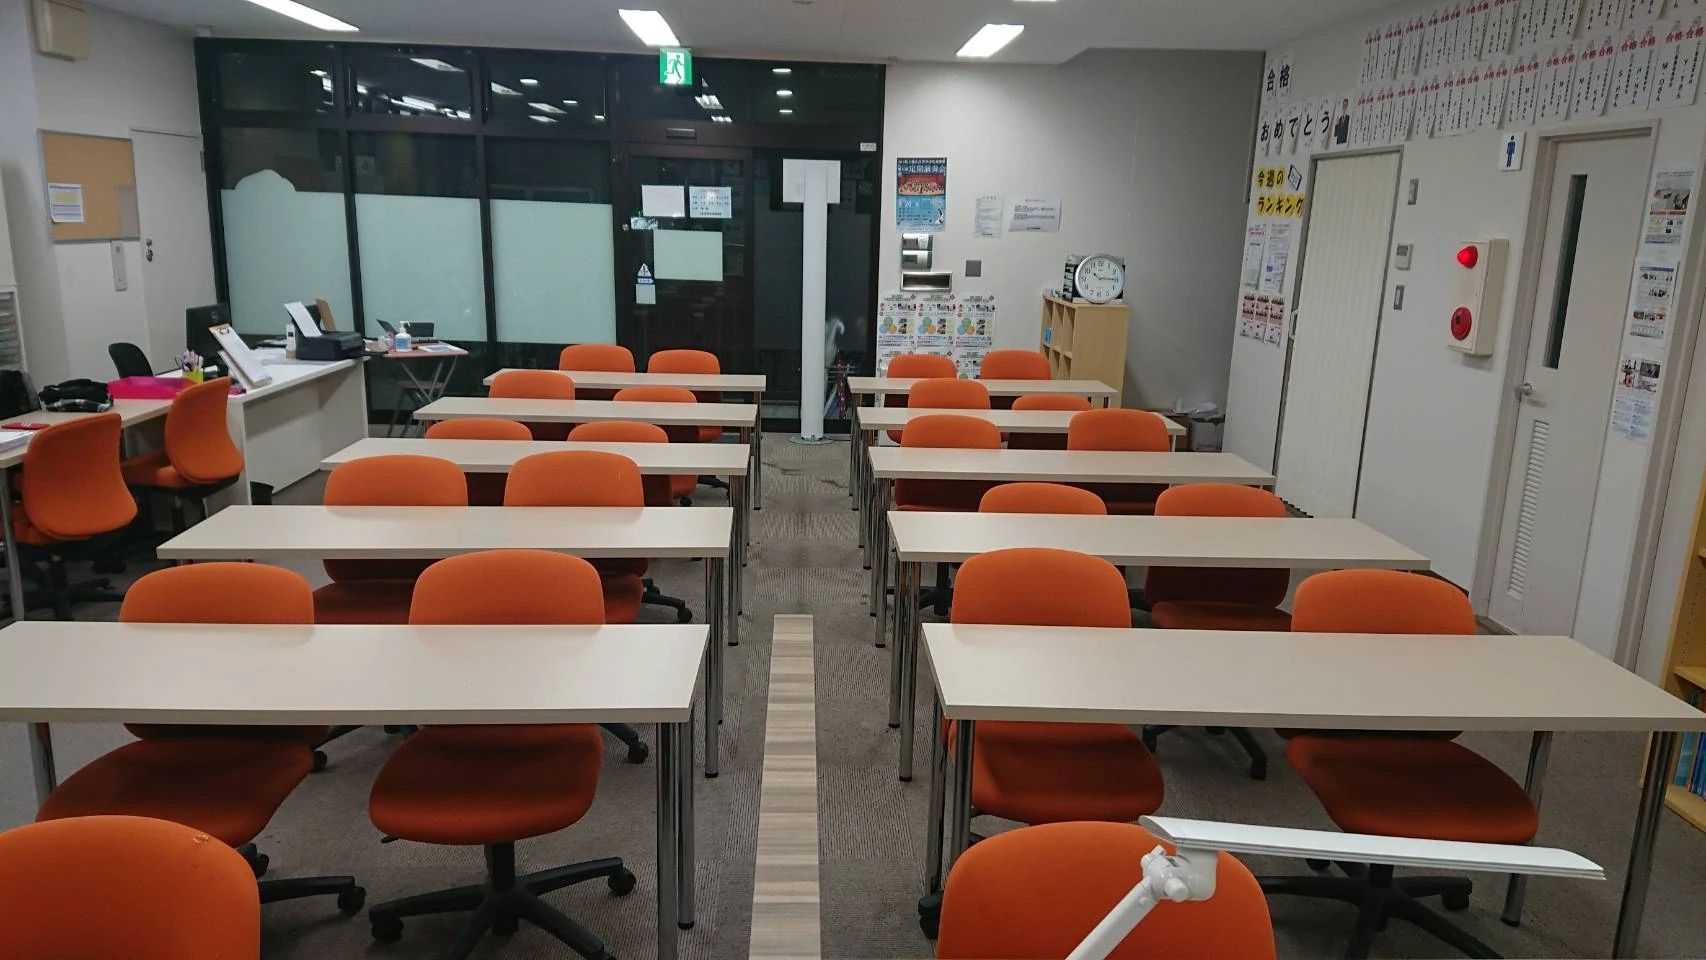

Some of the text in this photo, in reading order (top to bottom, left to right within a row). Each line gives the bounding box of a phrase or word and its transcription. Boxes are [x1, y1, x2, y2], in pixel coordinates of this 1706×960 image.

[1665, 31, 1683, 43] 合格
[1686, 26, 1704, 39] 合格
[1621, 40, 1637, 52] 合格
[1640, 36, 1656, 48] 合格
[1267, 64, 1290, 92] 合格
[1260, 111, 1330, 142] おめでとう
[1258, 170, 1284, 188] 今週の
[1258, 197, 1304, 214] ランキング
